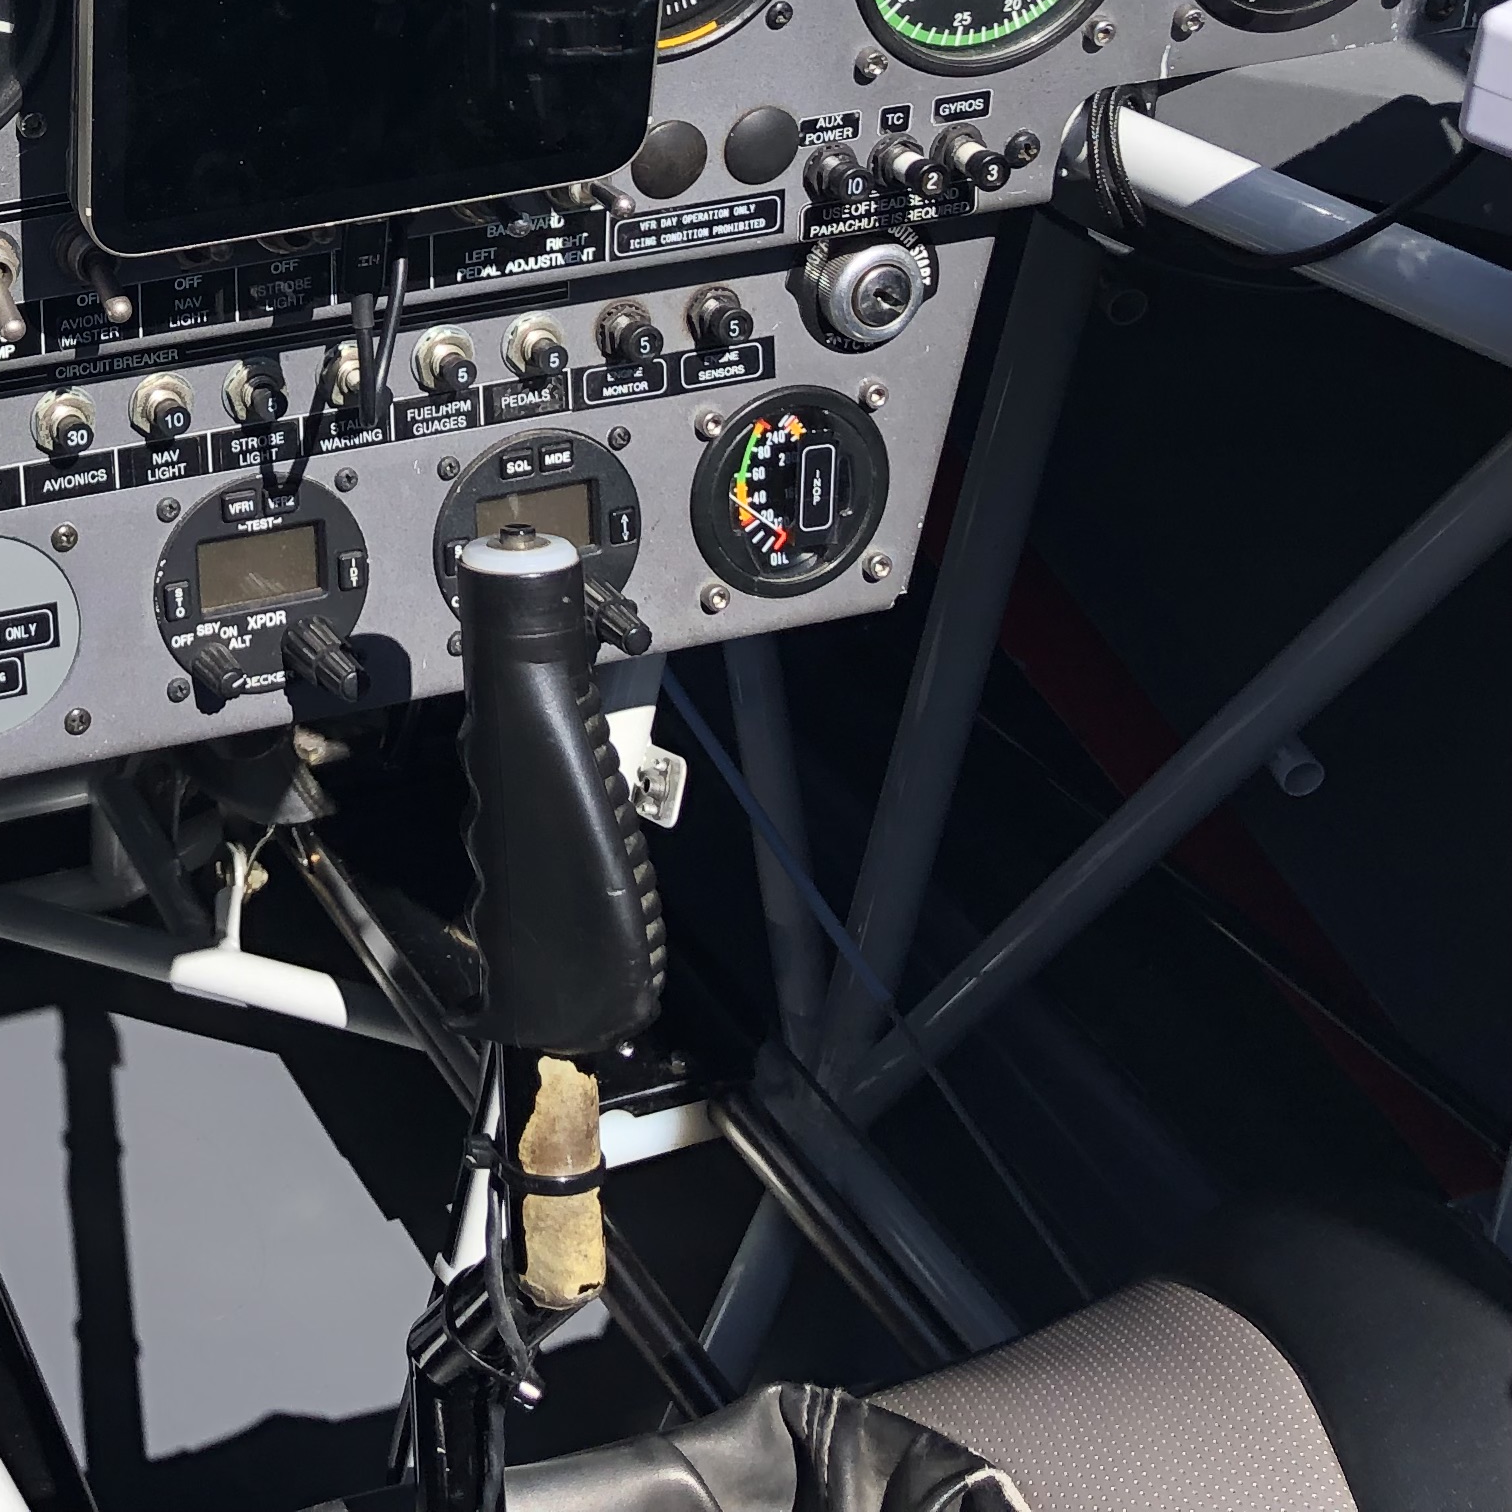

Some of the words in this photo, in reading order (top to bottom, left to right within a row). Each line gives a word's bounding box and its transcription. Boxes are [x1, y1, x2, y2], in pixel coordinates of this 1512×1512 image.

[954, 12, 972, 26] 25
[939, 98, 984, 116] GYROS
[817, 112, 843, 128] AUX
[886, 114, 904, 125] TC
[806, 124, 852, 144] POWER
[927, 173, 937, 190] 2
[988, 165, 998, 181] 3
[640, 221, 656, 231] VFR
[661, 217, 677, 227] DAY
[682, 209, 729, 224] OPERATION
[734, 204, 755, 216] ONLY
[810, 215, 887, 237] PARACHUTE
[891, 213, 902, 223] IS
[457, 264, 501, 282] PEDAL
[505, 247, 596, 274] ADJUSTMENT
[698, 365, 745, 380] SENSORS
[603, 382, 649, 397] MONITOR
[501, 389, 550, 408] PEDALS
[413, 416, 466, 435] GUAGES
[231, 432, 284, 452] STROBE
[152, 449, 179, 465] NAV
[43, 469, 107, 492] AVIONICS
[147, 464, 187, 481] LIGHT
[752, 467, 766, 480] 60
[813, 469, 821, 505] INOP
[753, 490, 766, 504] 40
[770, 552, 789, 566] OIL
[350, 558, 358, 587] IDT
[175, 588, 185, 617] STO
[247, 610, 286, 630] XPDR
[5, 621, 37, 641] ONLY
[196, 621, 221, 637] SBY
[220, 625, 237, 639] ON
[172, 633, 194, 648] OFF
[229, 635, 252, 649] ALT
